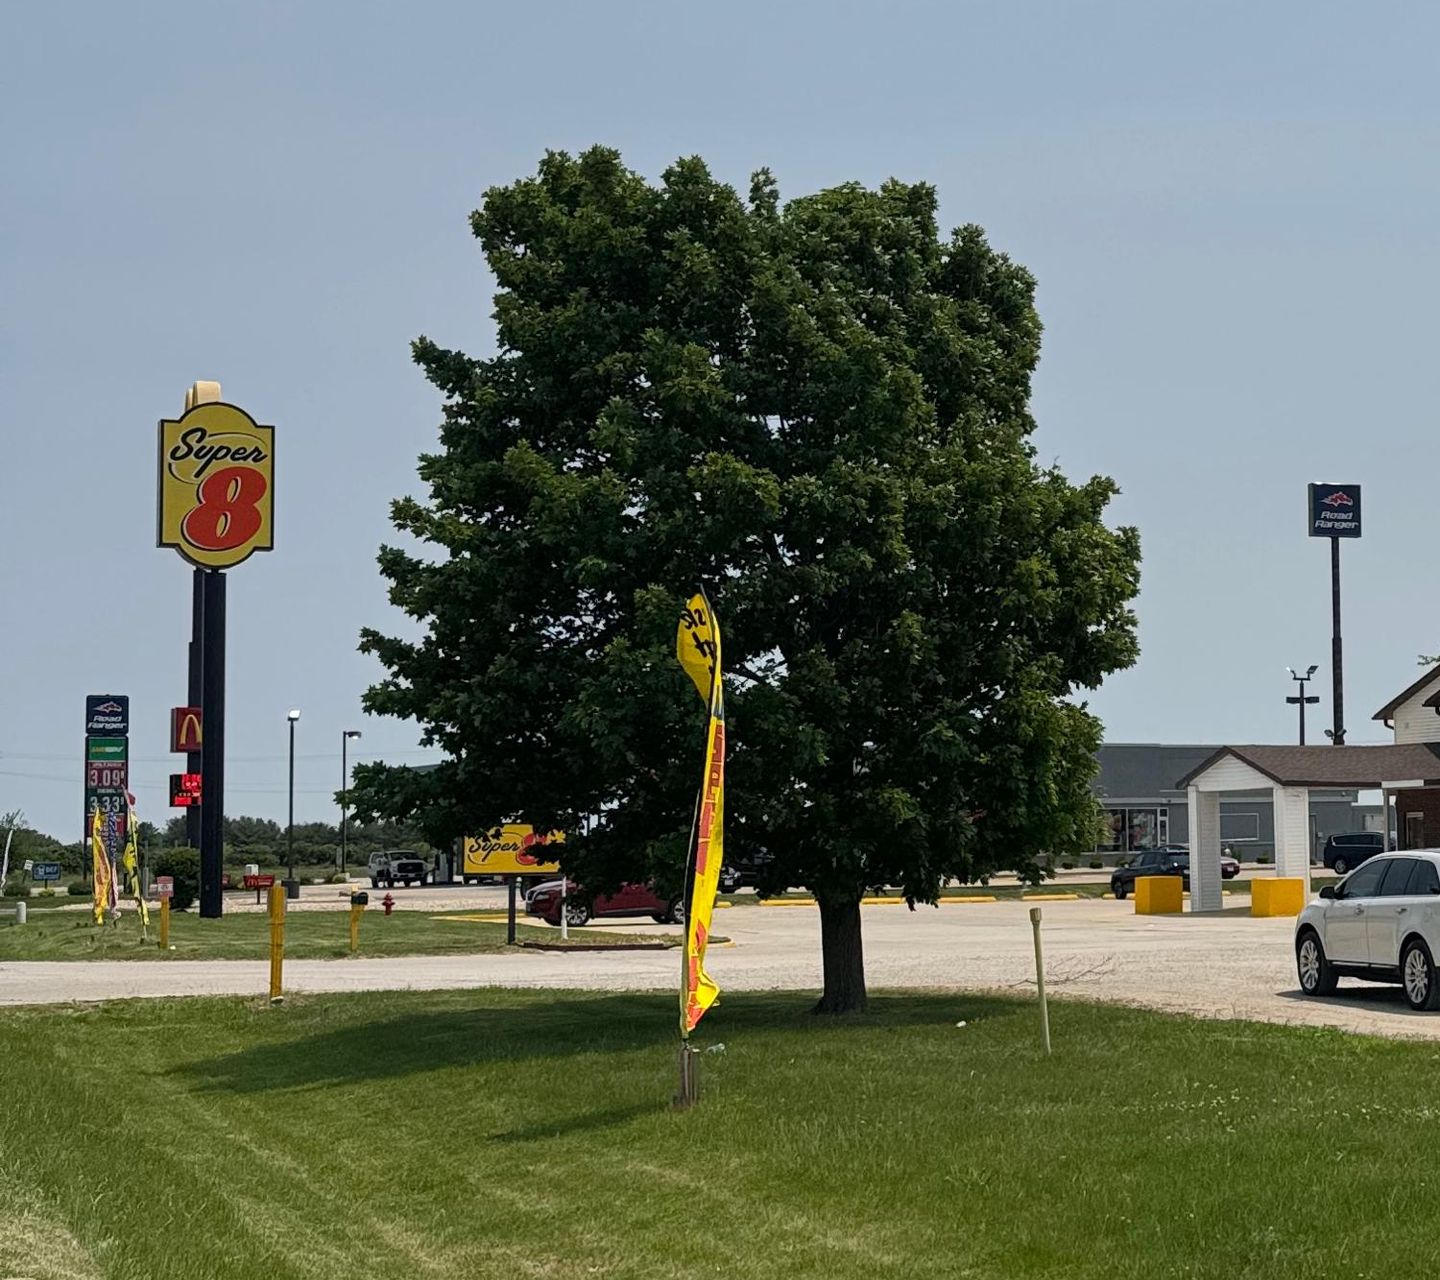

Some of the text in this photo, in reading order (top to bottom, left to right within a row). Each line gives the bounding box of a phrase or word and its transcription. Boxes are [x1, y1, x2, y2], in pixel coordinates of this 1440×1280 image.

[170, 427, 269, 478] Super
[181, 466, 267, 551] 8
[1321, 511, 1353, 519] Road
[1315, 520, 1359, 529] Ranger
[88, 722, 127, 730] Ranger
